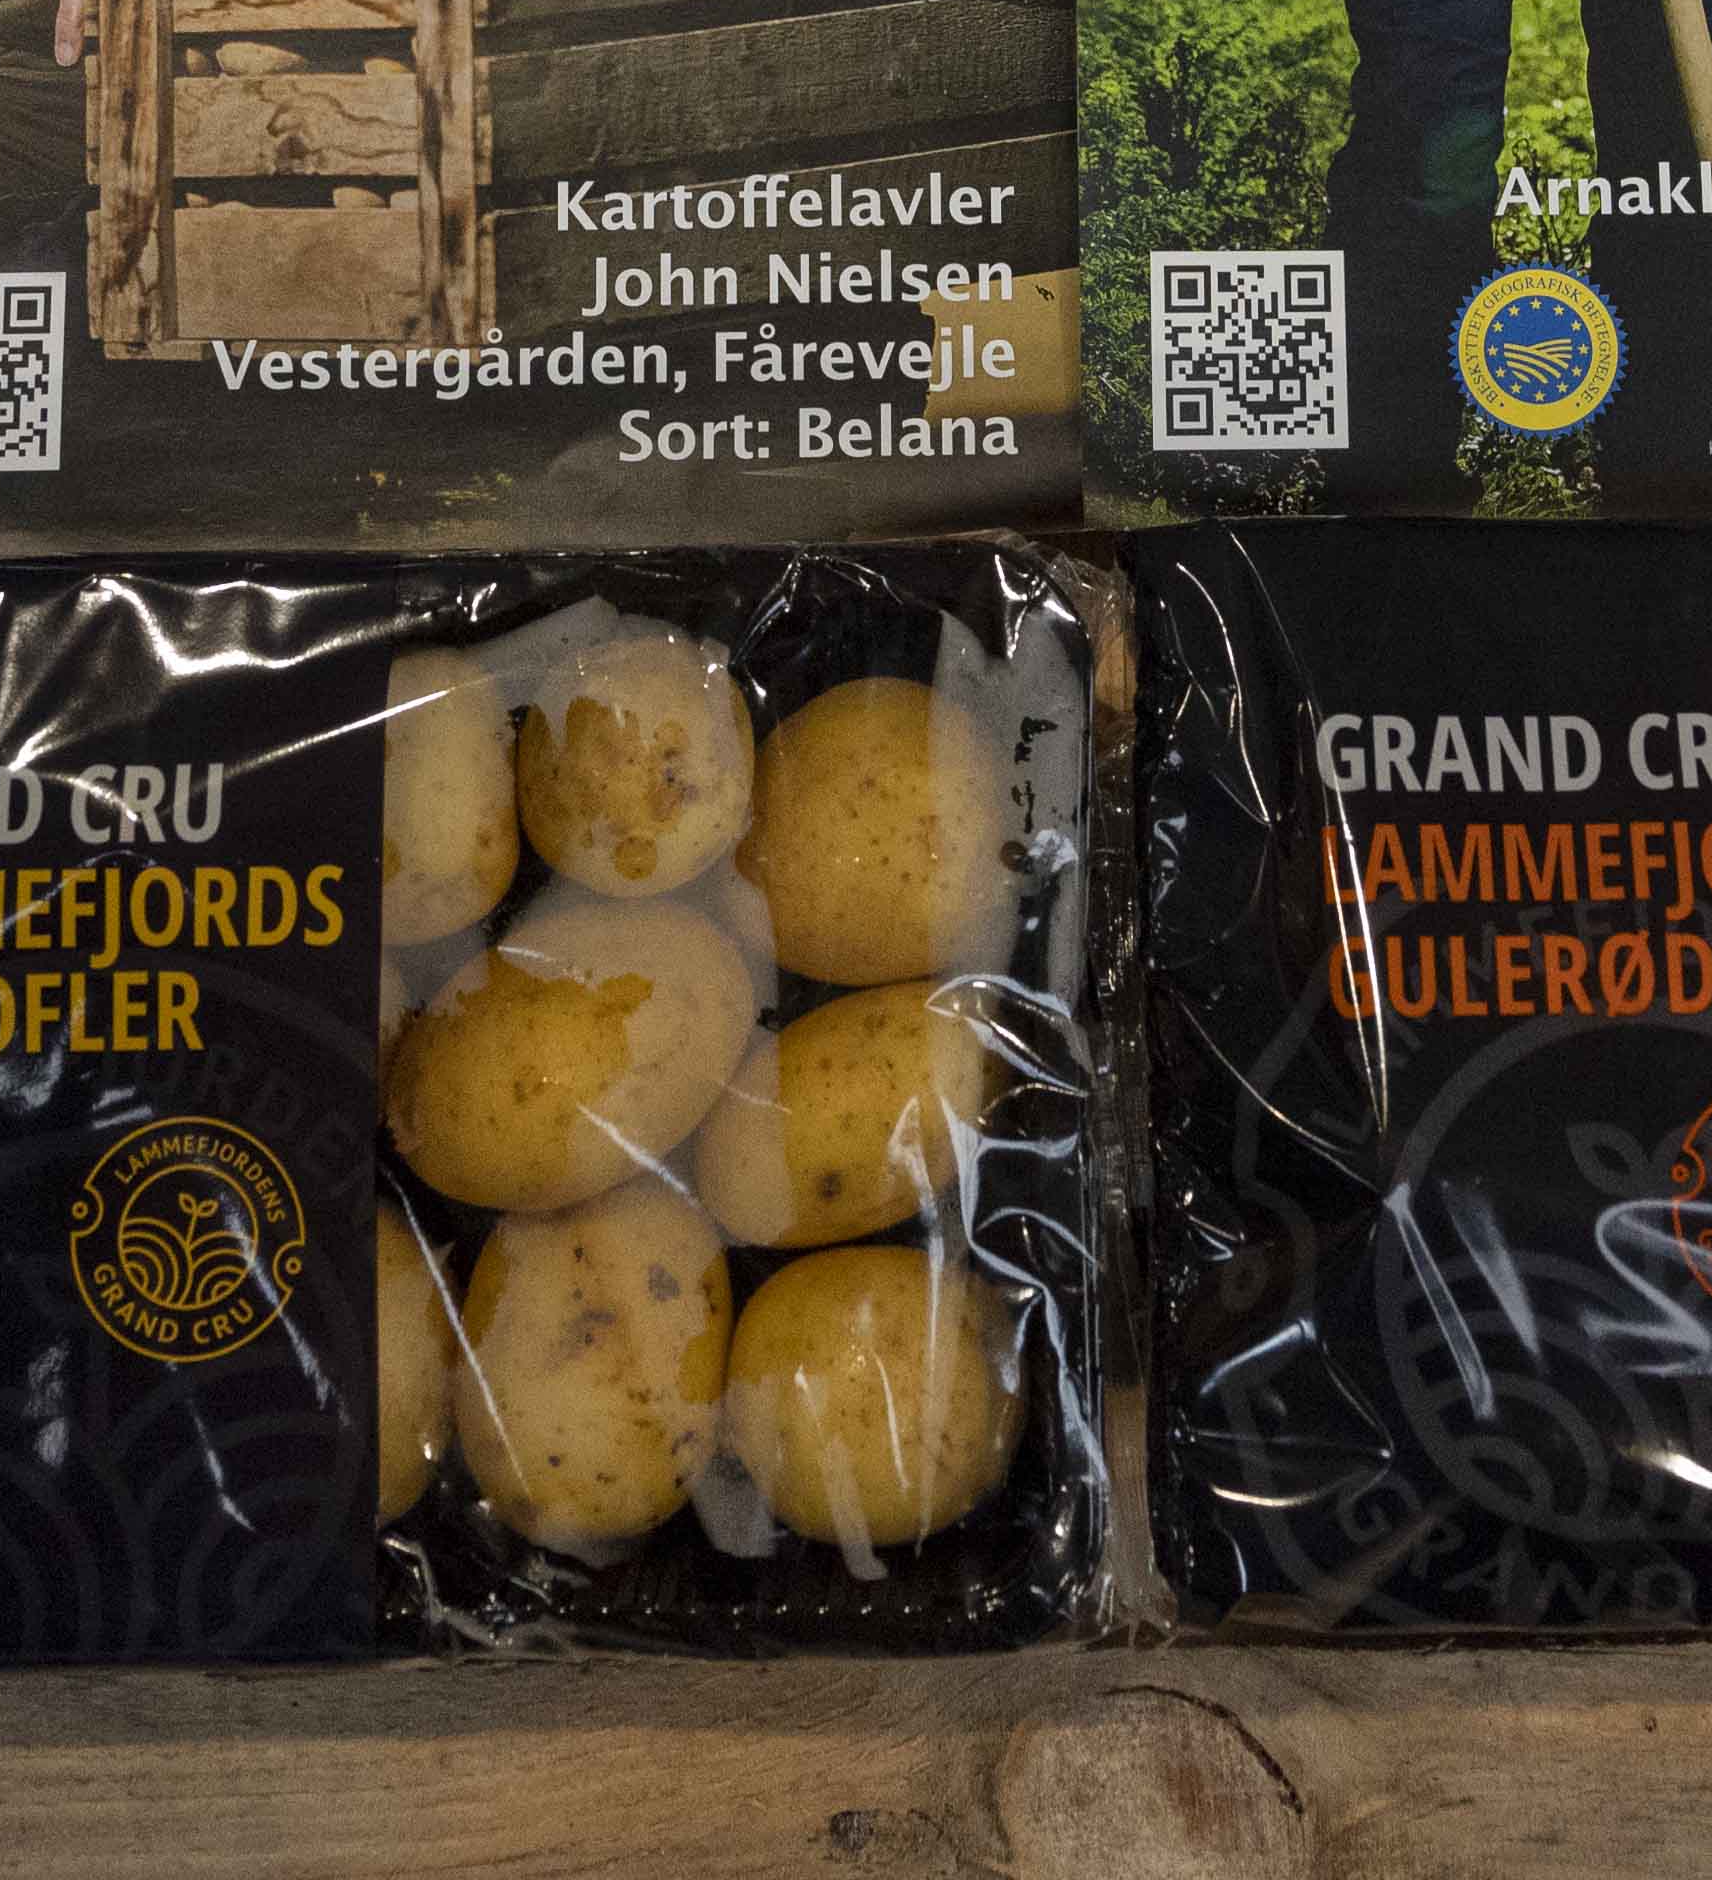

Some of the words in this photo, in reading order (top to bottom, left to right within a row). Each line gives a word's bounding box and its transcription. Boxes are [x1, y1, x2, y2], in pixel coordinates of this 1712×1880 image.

[556, 172, 1016, 233] Kartoffelavler
[582, 253, 738, 318] John
[767, 249, 1015, 304] Nielsen
[211, 327, 688, 401] Vestergården,
[714, 322, 1016, 391] Fårevejle
[1465, 310, 1498, 404] BESKYTTET
[1482, 276, 1582, 311] GEOGRAFISK
[1581, 299, 1612, 404] BETEGNELSE
[619, 408, 771, 464] Sort:
[797, 402, 1018, 459] Belana
[1314, 712, 1603, 793] GRAND
[69, 762, 225, 846] CRU
[113, 1134, 286, 1224] LAMMEFJORDENS
[93, 1263, 179, 1344] GRAND
[192, 1297, 255, 1345] CRU
